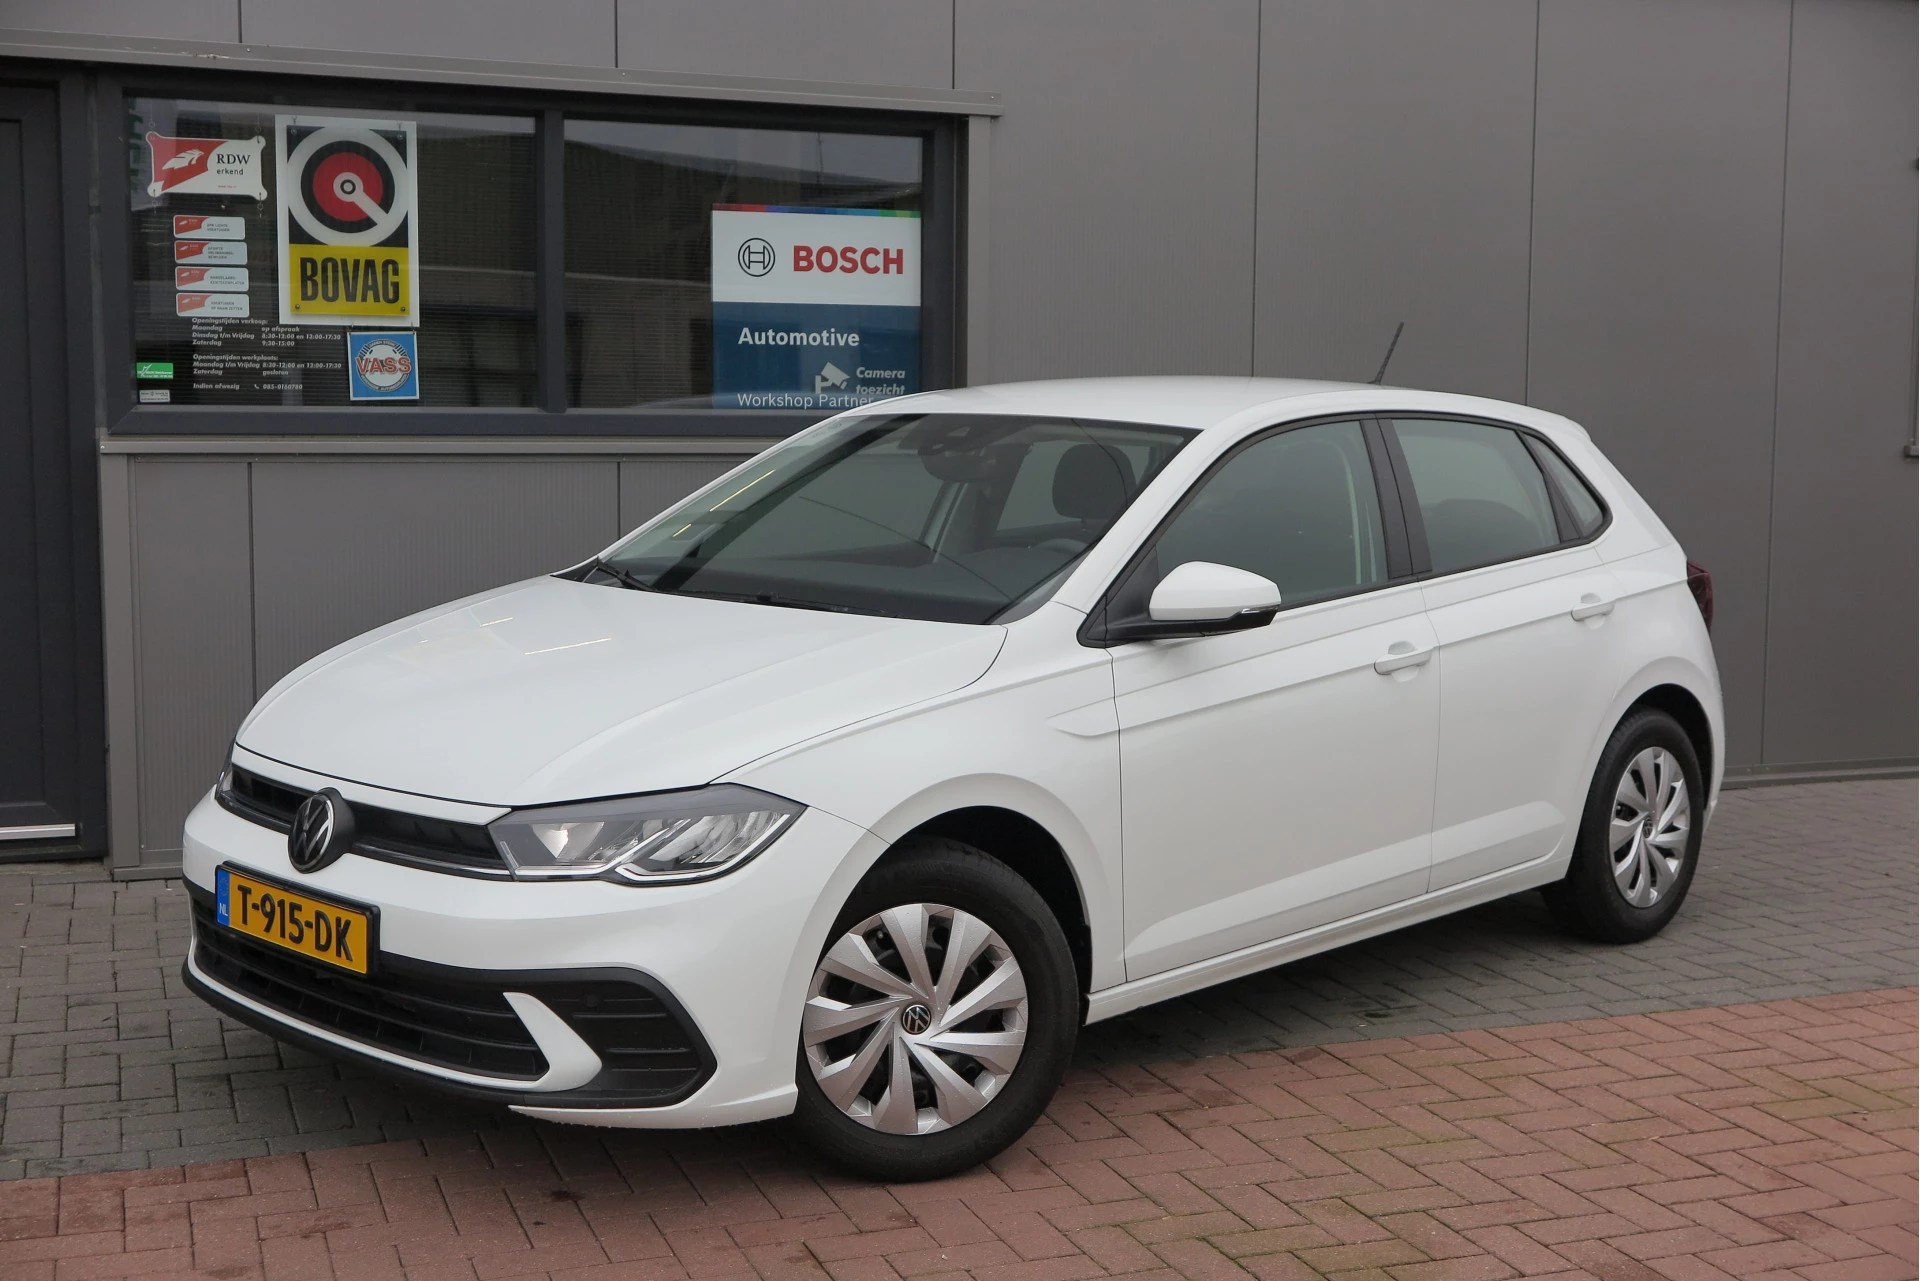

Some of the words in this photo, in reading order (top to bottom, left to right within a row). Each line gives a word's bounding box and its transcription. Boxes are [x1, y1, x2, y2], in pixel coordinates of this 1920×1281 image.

[216, 153, 251, 165] RDW
[216, 168, 244, 176] erkend
[793, 245, 904, 275] BOSCH
[300, 256, 400, 304] BOVAG
[192, 317, 240, 325] Openingstijden
[738, 327, 860, 347] Automotive
[193, 353, 241, 361] Openingstijden
[355, 355, 412, 375] VASS
[856, 366, 906, 379] Camera
[855, 383, 906, 395] toezicht
[737, 393, 813, 410] Workshop
[819, 393, 873, 407] Partner
[219, 902, 229, 917] NL
[237, 884, 353, 962] T-915-DK
